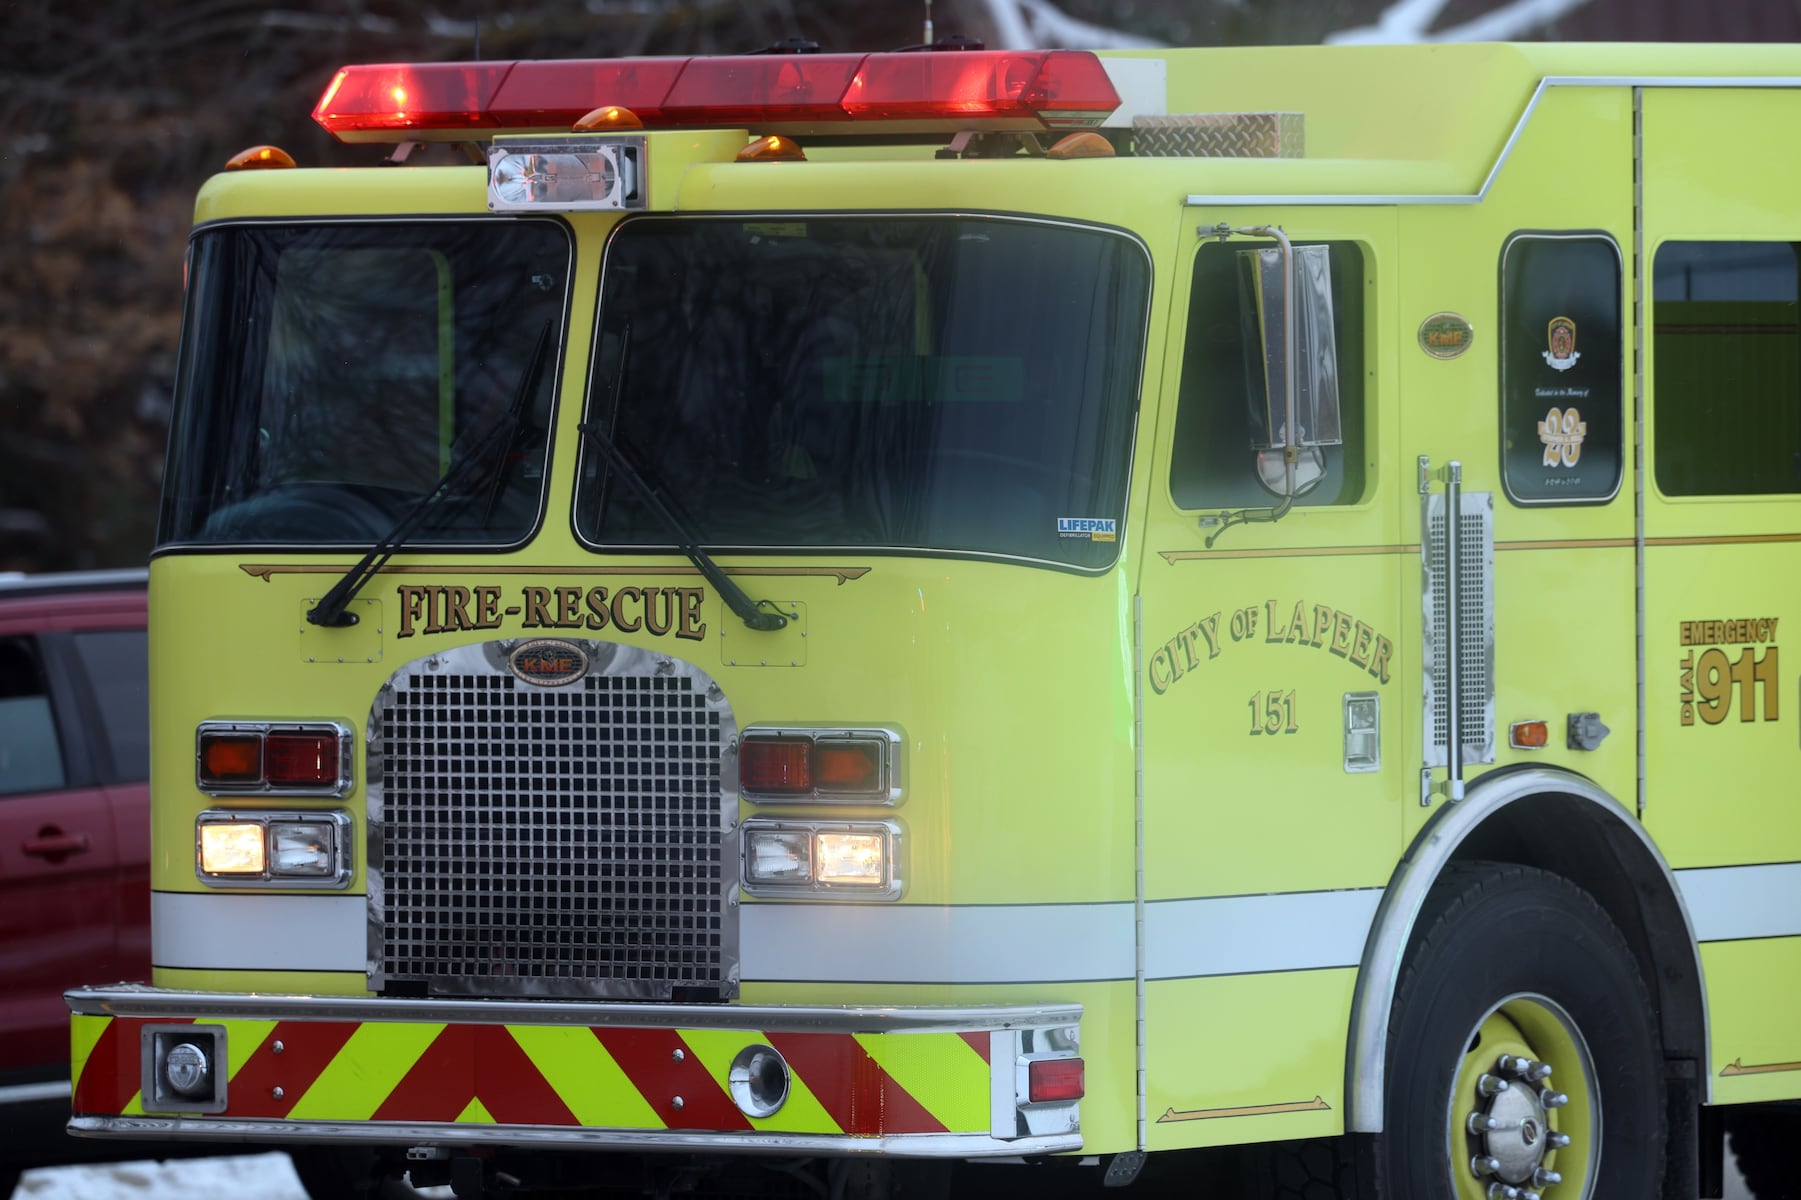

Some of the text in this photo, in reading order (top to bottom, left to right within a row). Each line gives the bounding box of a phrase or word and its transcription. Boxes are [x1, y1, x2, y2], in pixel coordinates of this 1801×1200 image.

[1059, 519, 1114, 532] LIFEPAK
[397, 584, 706, 641] FIRE-RESCUE
[1680, 617, 1779, 646] EMERGENCY
[523, 656, 573, 673] KME
[1149, 600, 1394, 695] CITY OF LAPEER
[1680, 649, 1694, 726] DIAL
[1696, 646, 1779, 725] 911
[1248, 690, 1298, 736] 151
